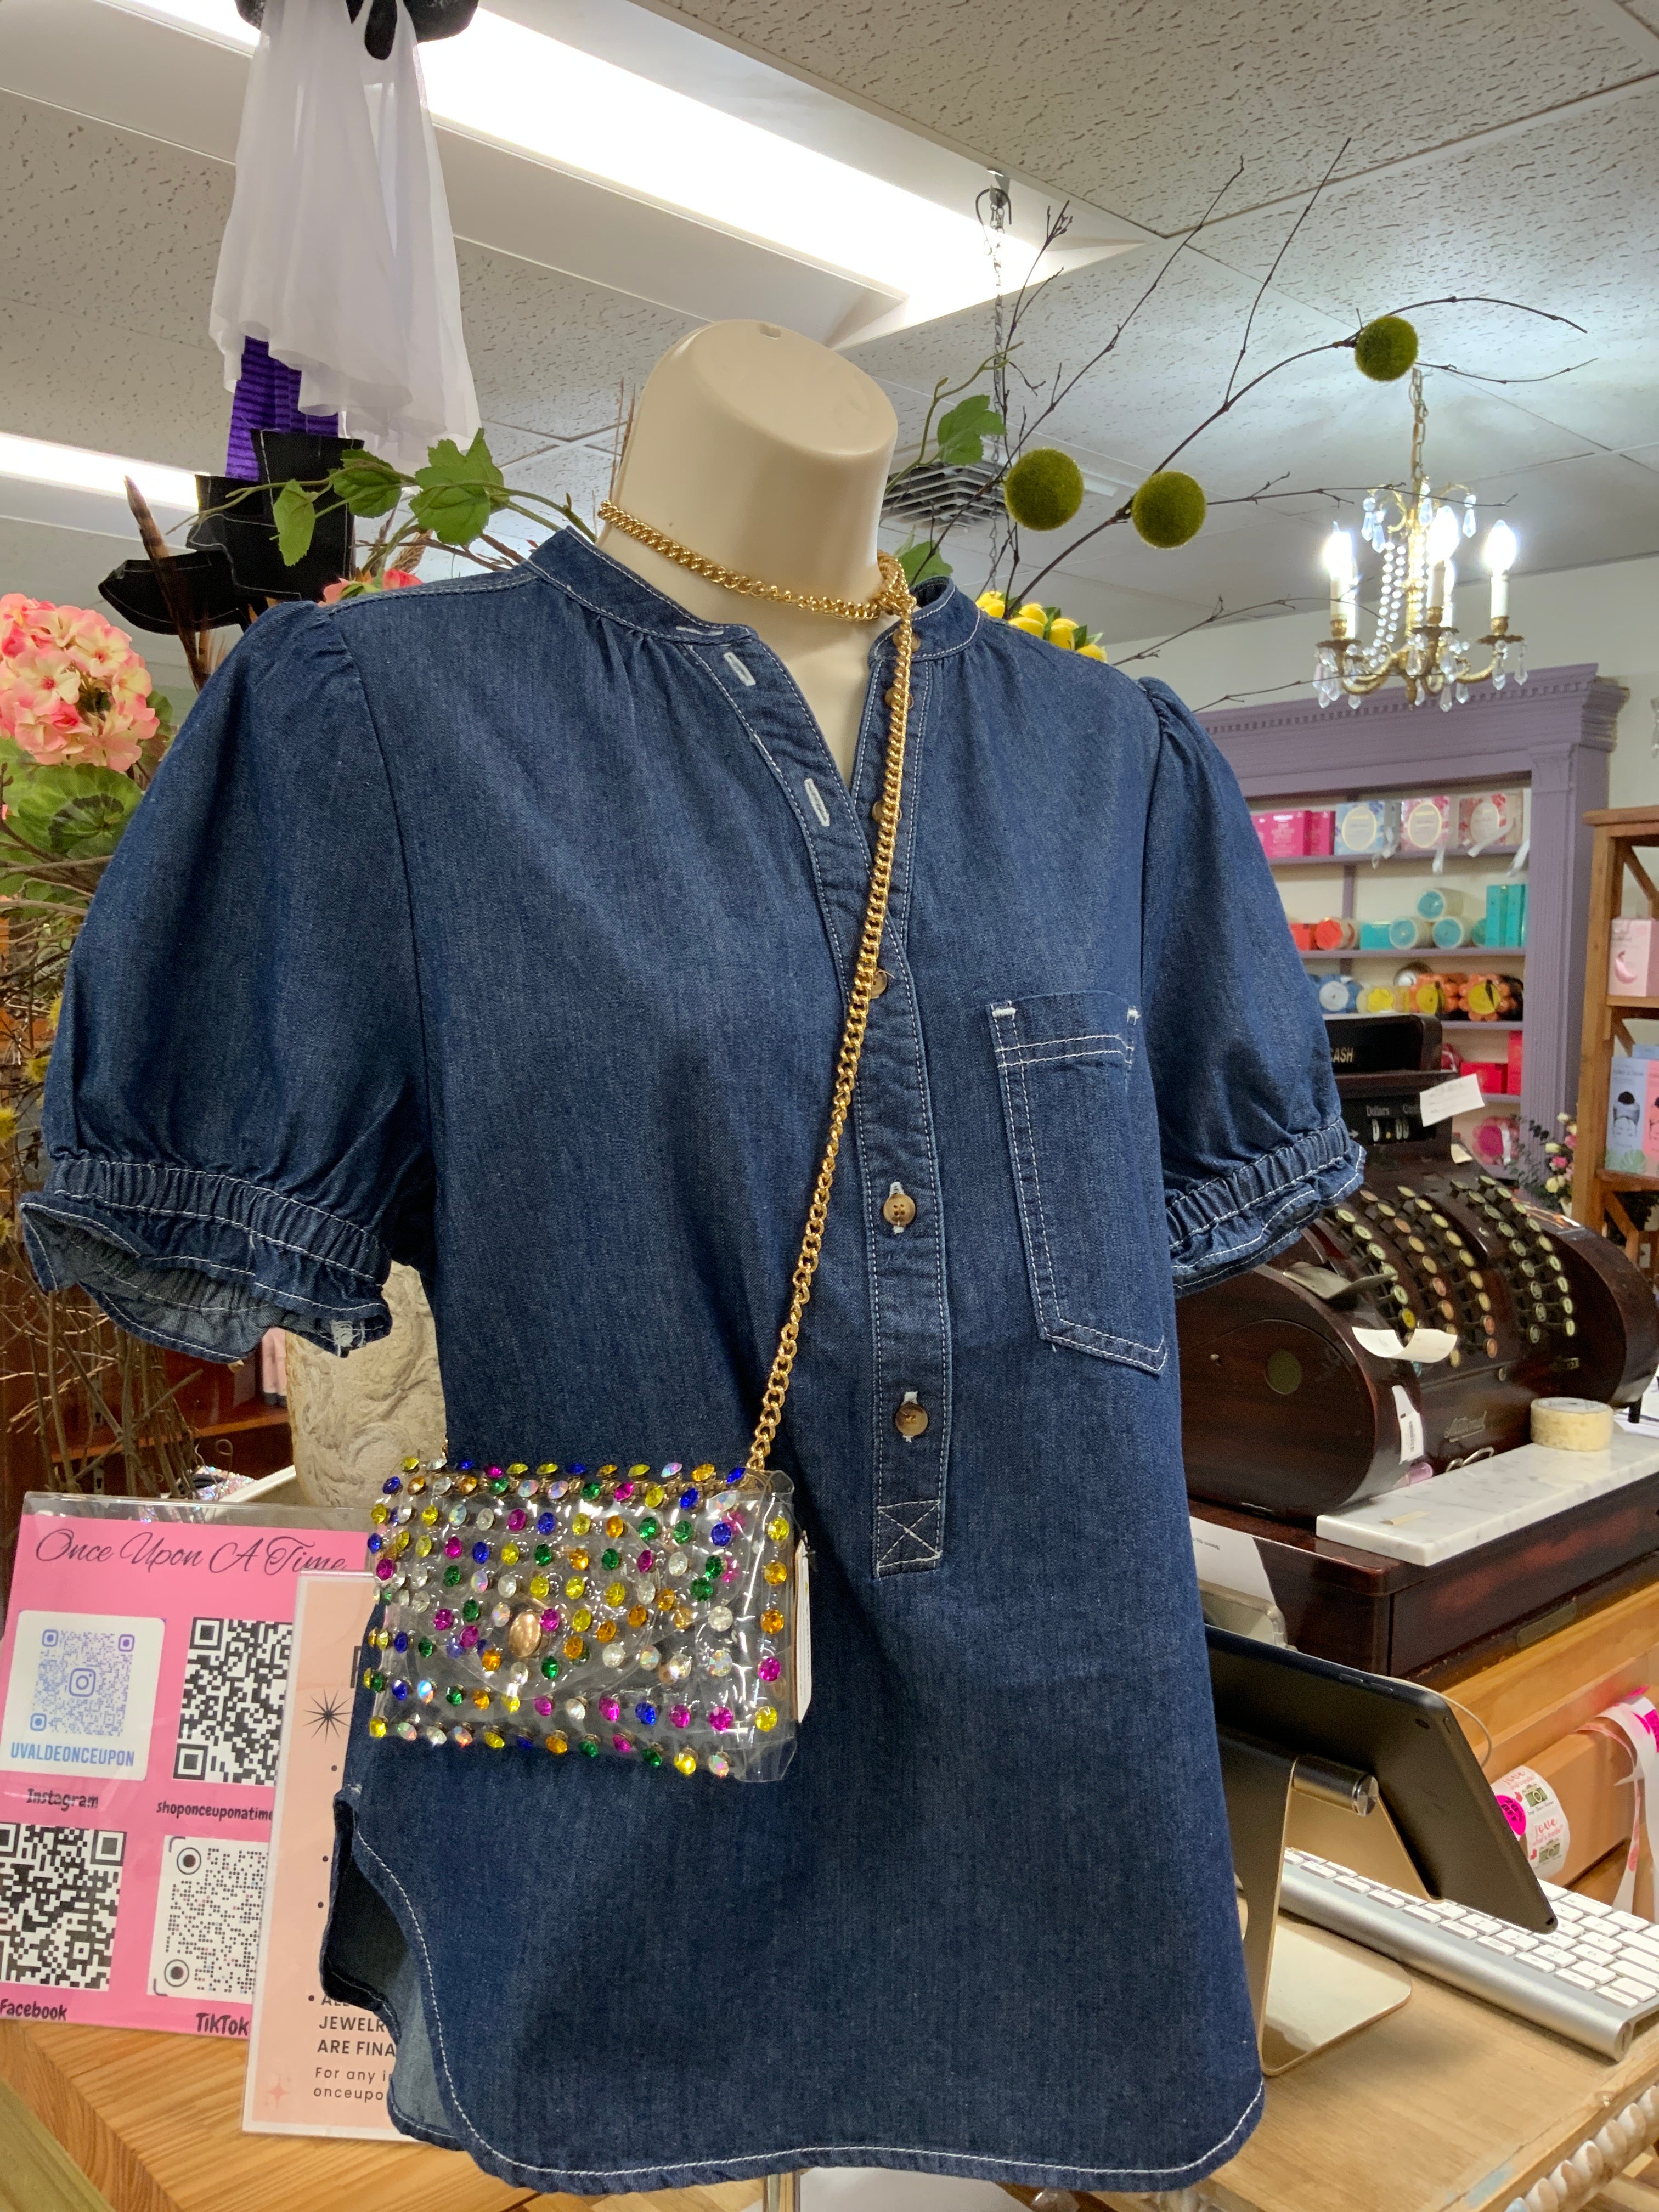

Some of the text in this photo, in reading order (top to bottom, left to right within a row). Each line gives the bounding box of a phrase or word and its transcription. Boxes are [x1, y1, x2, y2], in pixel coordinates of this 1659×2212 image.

[1331, 1047, 1354, 1063] ASH
[36, 1528, 347, 1576] Once Upon A Time
[10, 1742, 134, 1767] UVALDEONCEUPON
[26, 1788, 98, 1812] Instagram
[0, 1999, 67, 2021] Facebook
[196, 2012, 249, 2036] TikTok
[317, 2039, 350, 2054] ARE
[315, 2067, 339, 2079] For
[346, 2070, 375, 2084] any
[314, 2087, 383, 2103] onceupo
